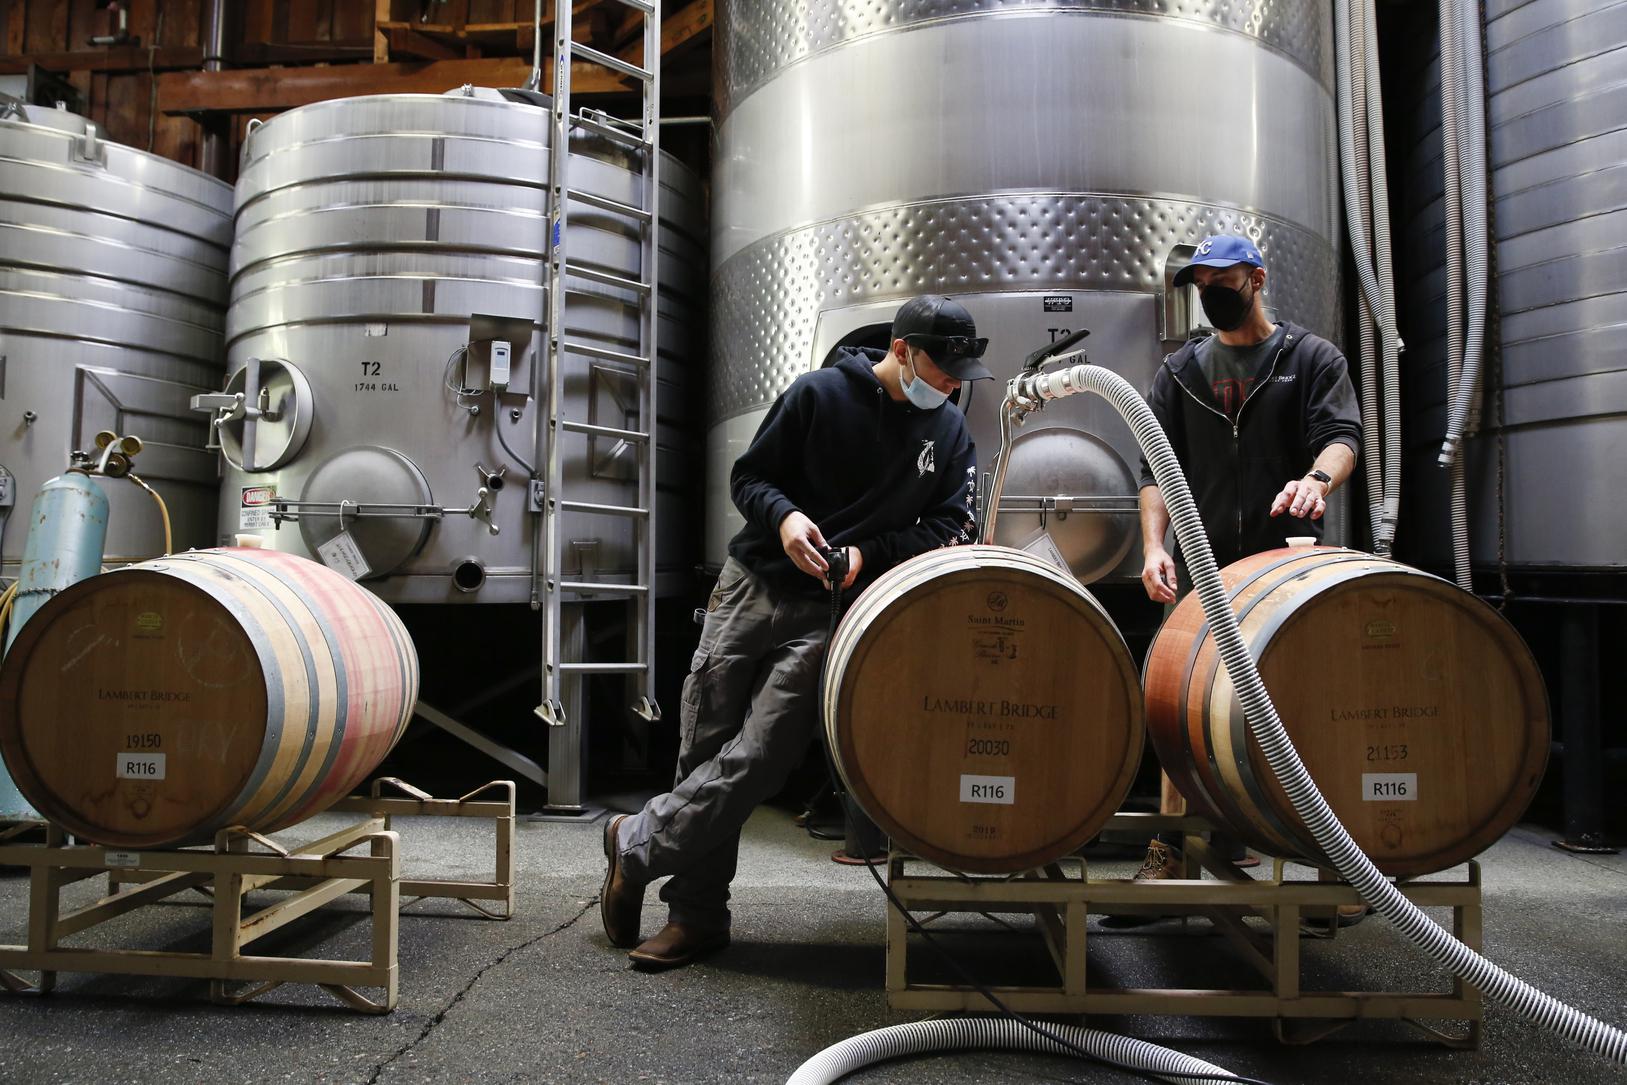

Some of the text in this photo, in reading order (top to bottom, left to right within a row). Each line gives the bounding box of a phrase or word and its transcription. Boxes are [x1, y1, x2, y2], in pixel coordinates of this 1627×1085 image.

[1069, 354, 1091, 364] GAL
[361, 361, 381, 376] T2
[355, 383, 399, 392] 1744 GAL
[967, 614, 1025, 627] Saint Martin
[98, 688, 192, 702] LAMBERT BRIDGE
[923, 695, 1059, 720] LAMBERT BRIDGE
[1330, 706, 1441, 721] LAMBERT BRIDGE
[126, 733, 161, 749] 19150
[968, 738, 1010, 756] 20030
[1367, 744, 1408, 761] 21153
[126, 761, 156, 775] R116
[971, 784, 1005, 799] R116
[1373, 782, 1407, 796] R116
